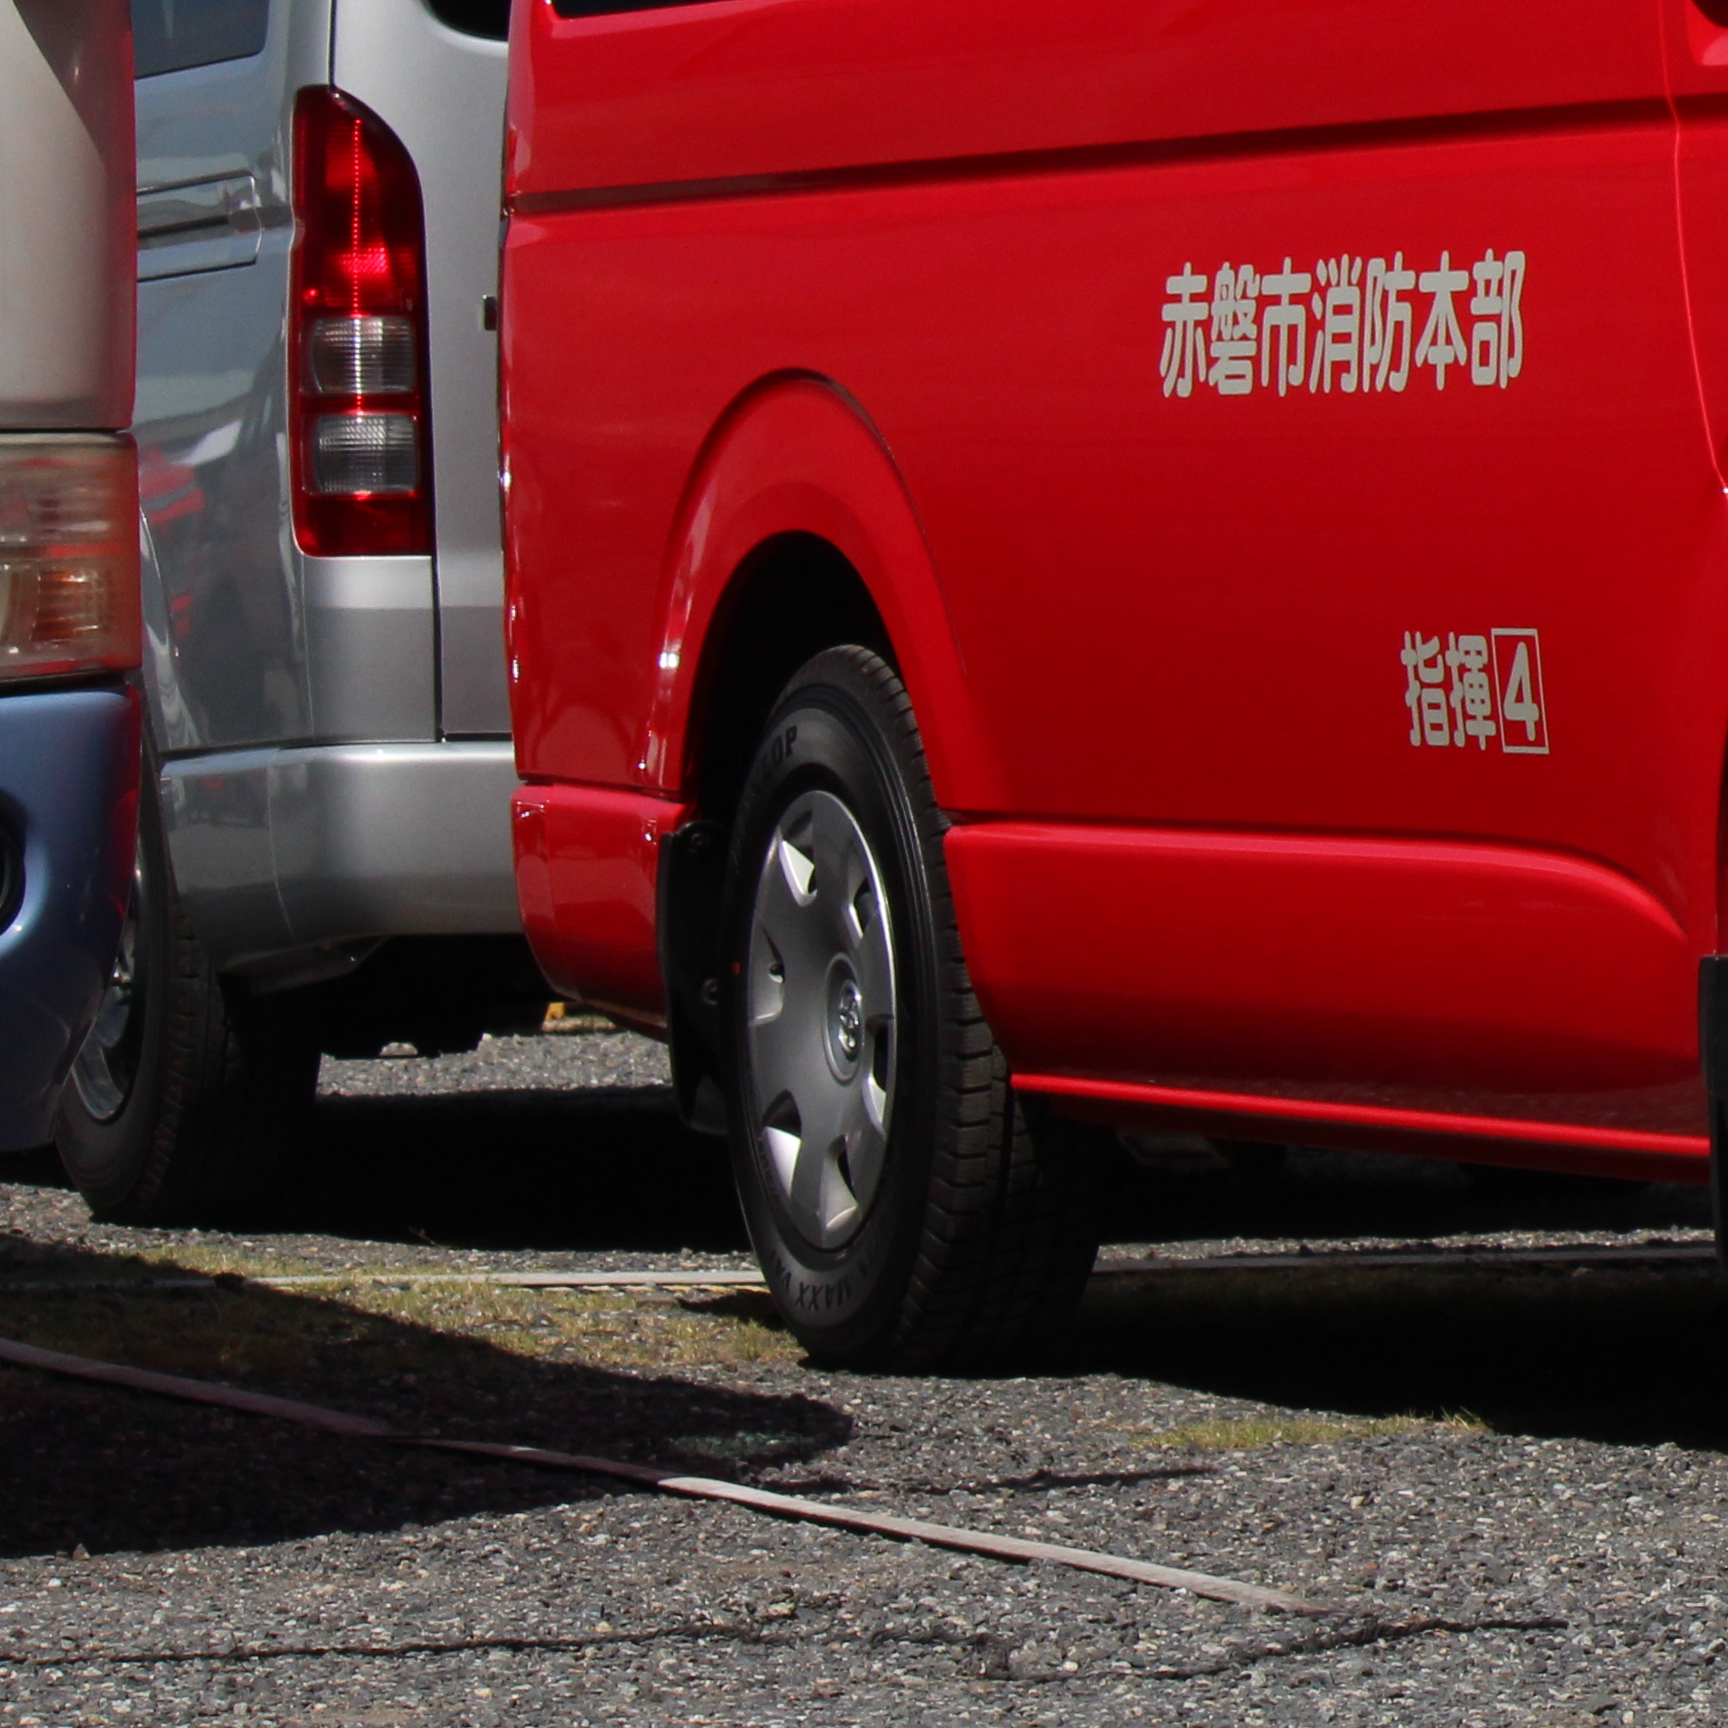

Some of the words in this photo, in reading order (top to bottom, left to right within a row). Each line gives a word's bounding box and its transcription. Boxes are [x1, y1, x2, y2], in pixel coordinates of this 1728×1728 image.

[1159, 247, 1526, 399] 赤磐市消防本部
